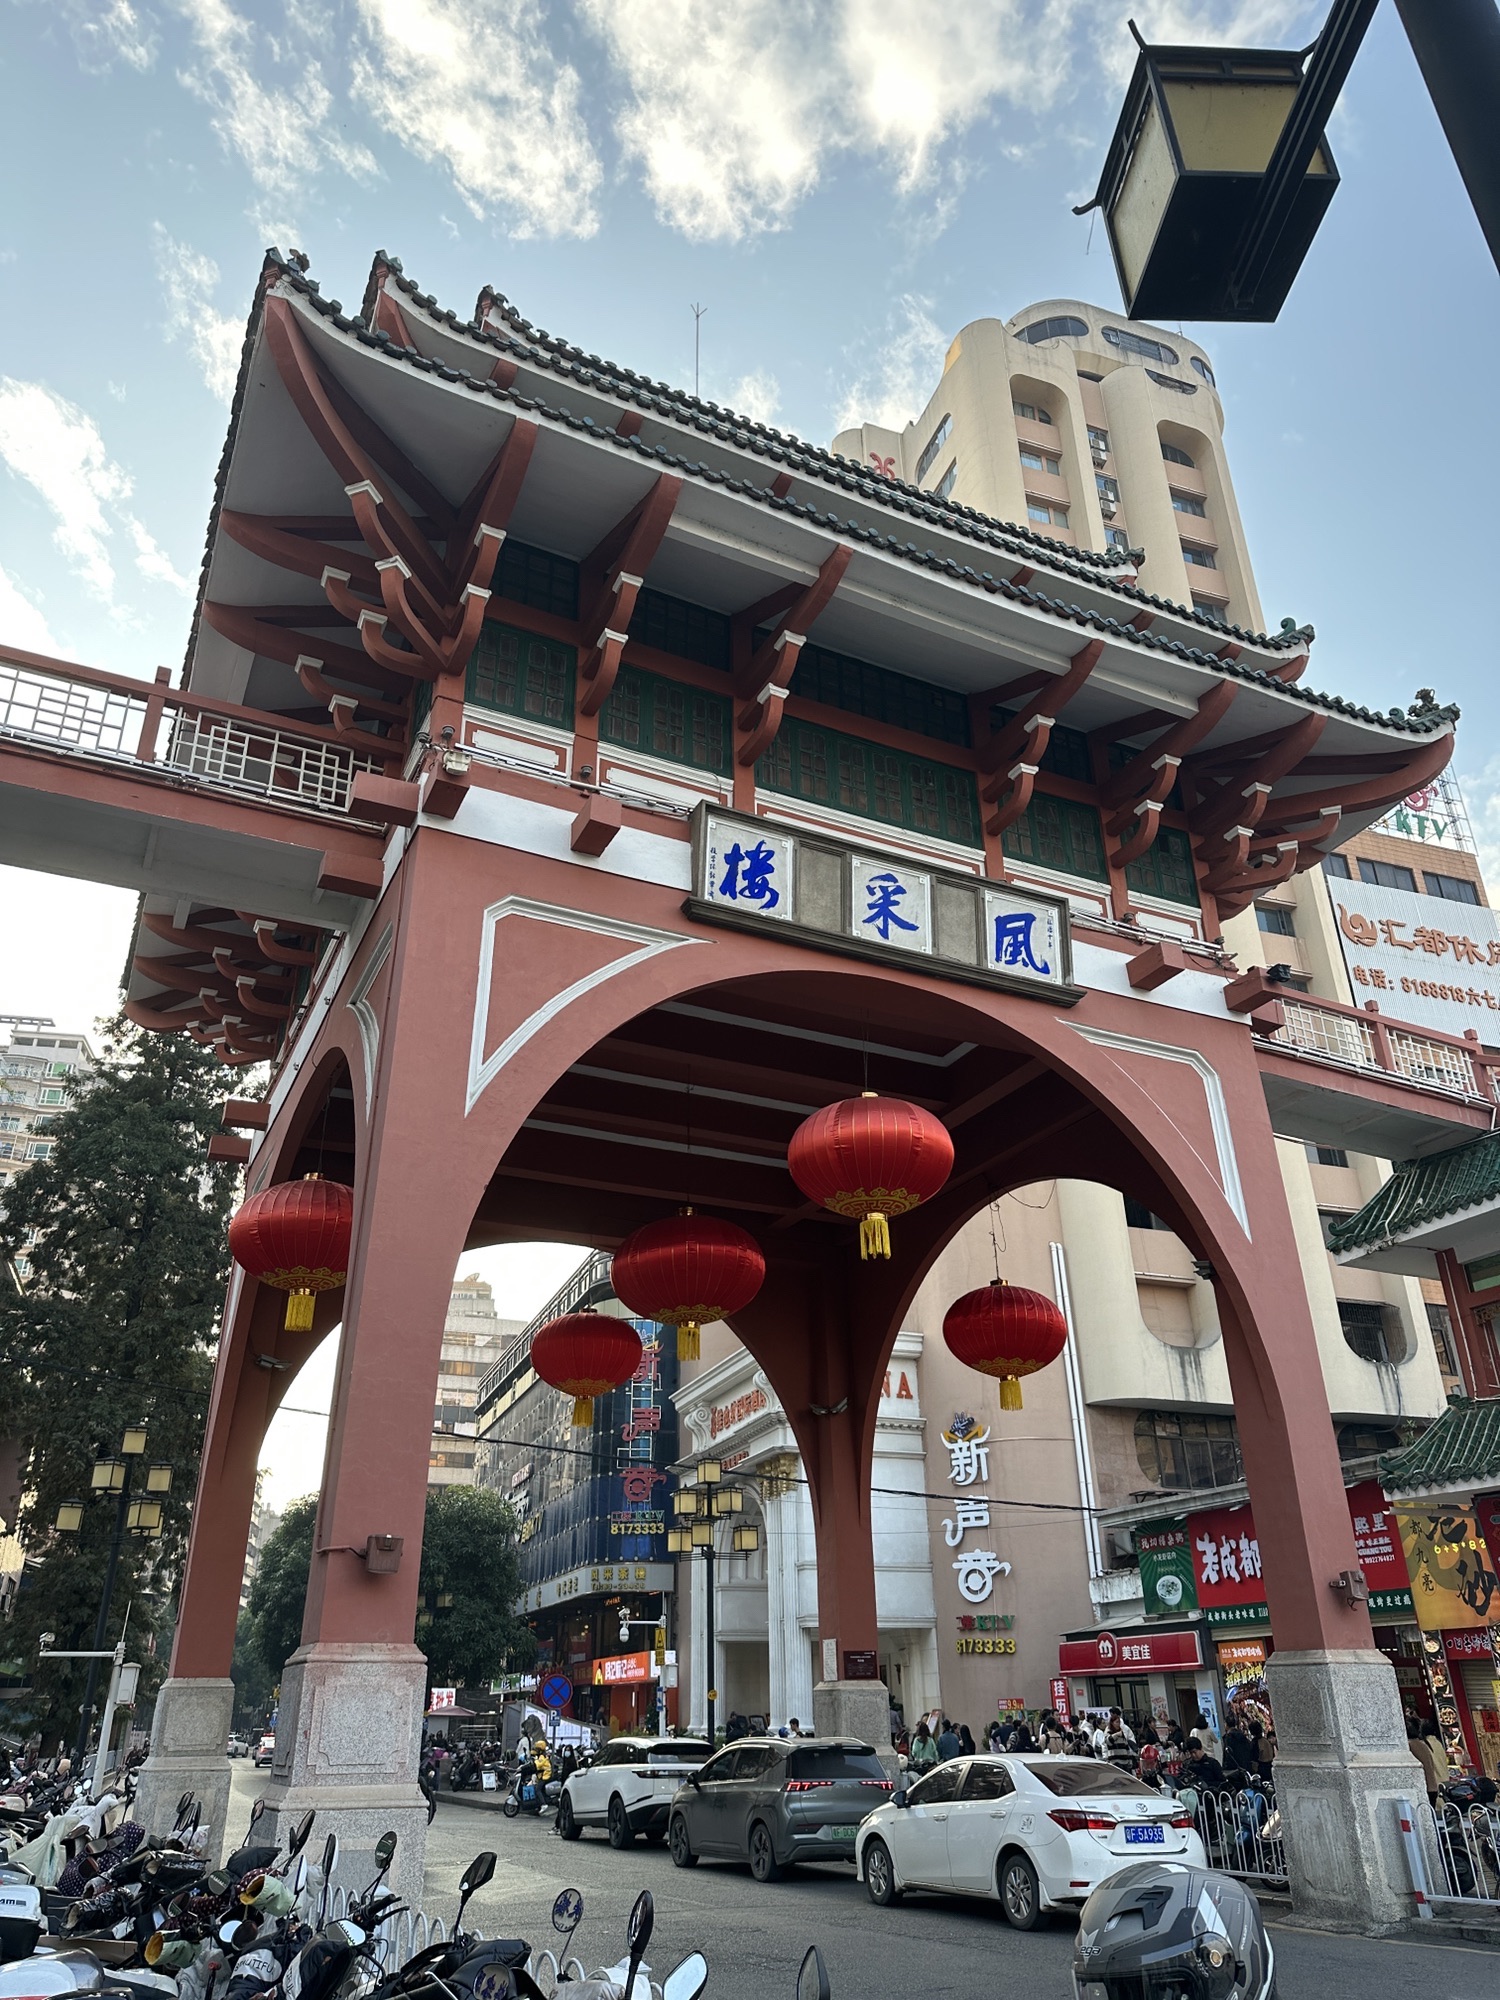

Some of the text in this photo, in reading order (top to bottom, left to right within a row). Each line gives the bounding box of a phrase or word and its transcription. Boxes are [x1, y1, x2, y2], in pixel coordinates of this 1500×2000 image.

[1396, 810, 1449, 840] KTV
[610, 1522, 665, 1535] 8173333
[976, 1614, 1016, 1631] KTV
[956, 1638, 1016, 1654] 8173333
[1122, 1644, 1151, 1661] 美宜佳
[1053, 1680, 1067, 1713] 挂历
